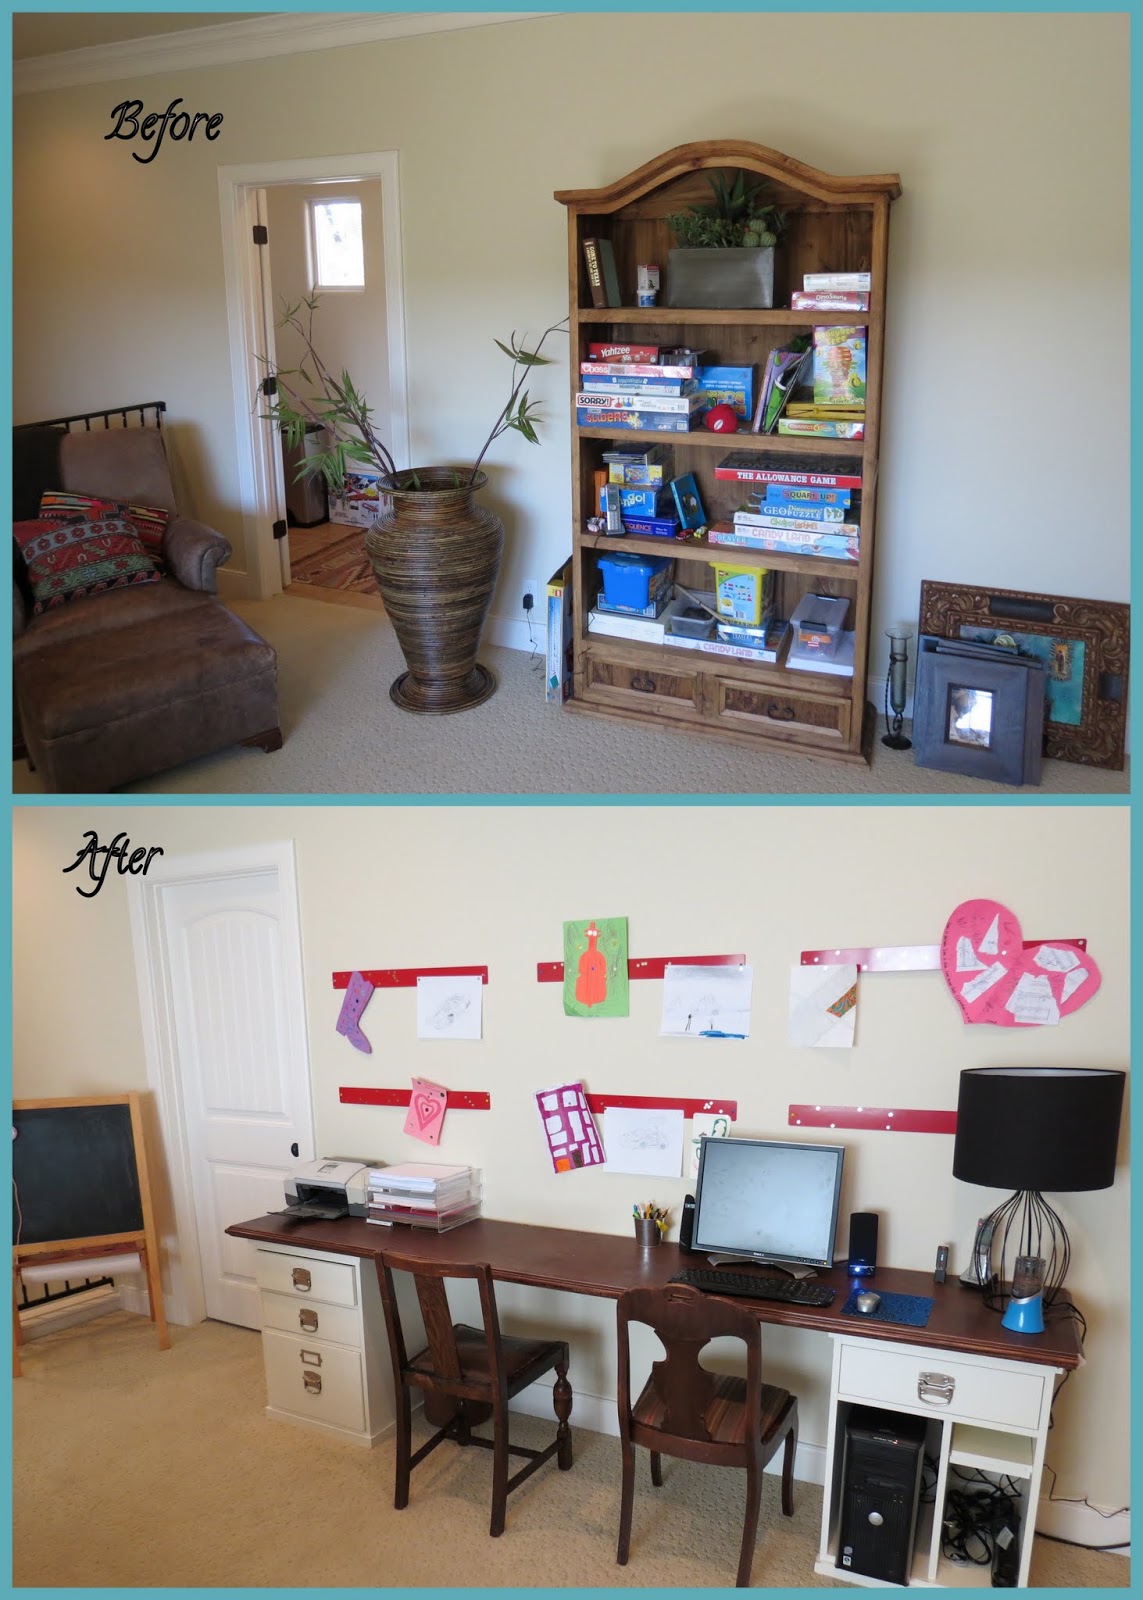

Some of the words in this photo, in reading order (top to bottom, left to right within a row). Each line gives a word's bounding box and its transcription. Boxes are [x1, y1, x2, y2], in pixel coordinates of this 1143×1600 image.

[600, 346, 631, 358] Yahtzee
[581, 363, 609, 373] Chess
[579, 396, 610, 406] SORRY!
[737, 472, 754, 480] THE
[755, 473, 808, 484] ALLOWANCE
[810, 476, 837, 486] GAME
[620, 492, 646, 507] ngo!
[784, 490, 819, 501] SQUARE
[625, 521, 653, 532] EQUENCE
[716, 533, 747, 545] DENVER
[751, 528, 784, 540] CANDY
[786, 531, 811, 543] LAND
[703, 643, 731, 654] CANDY
[731, 646, 754, 658] LAND
